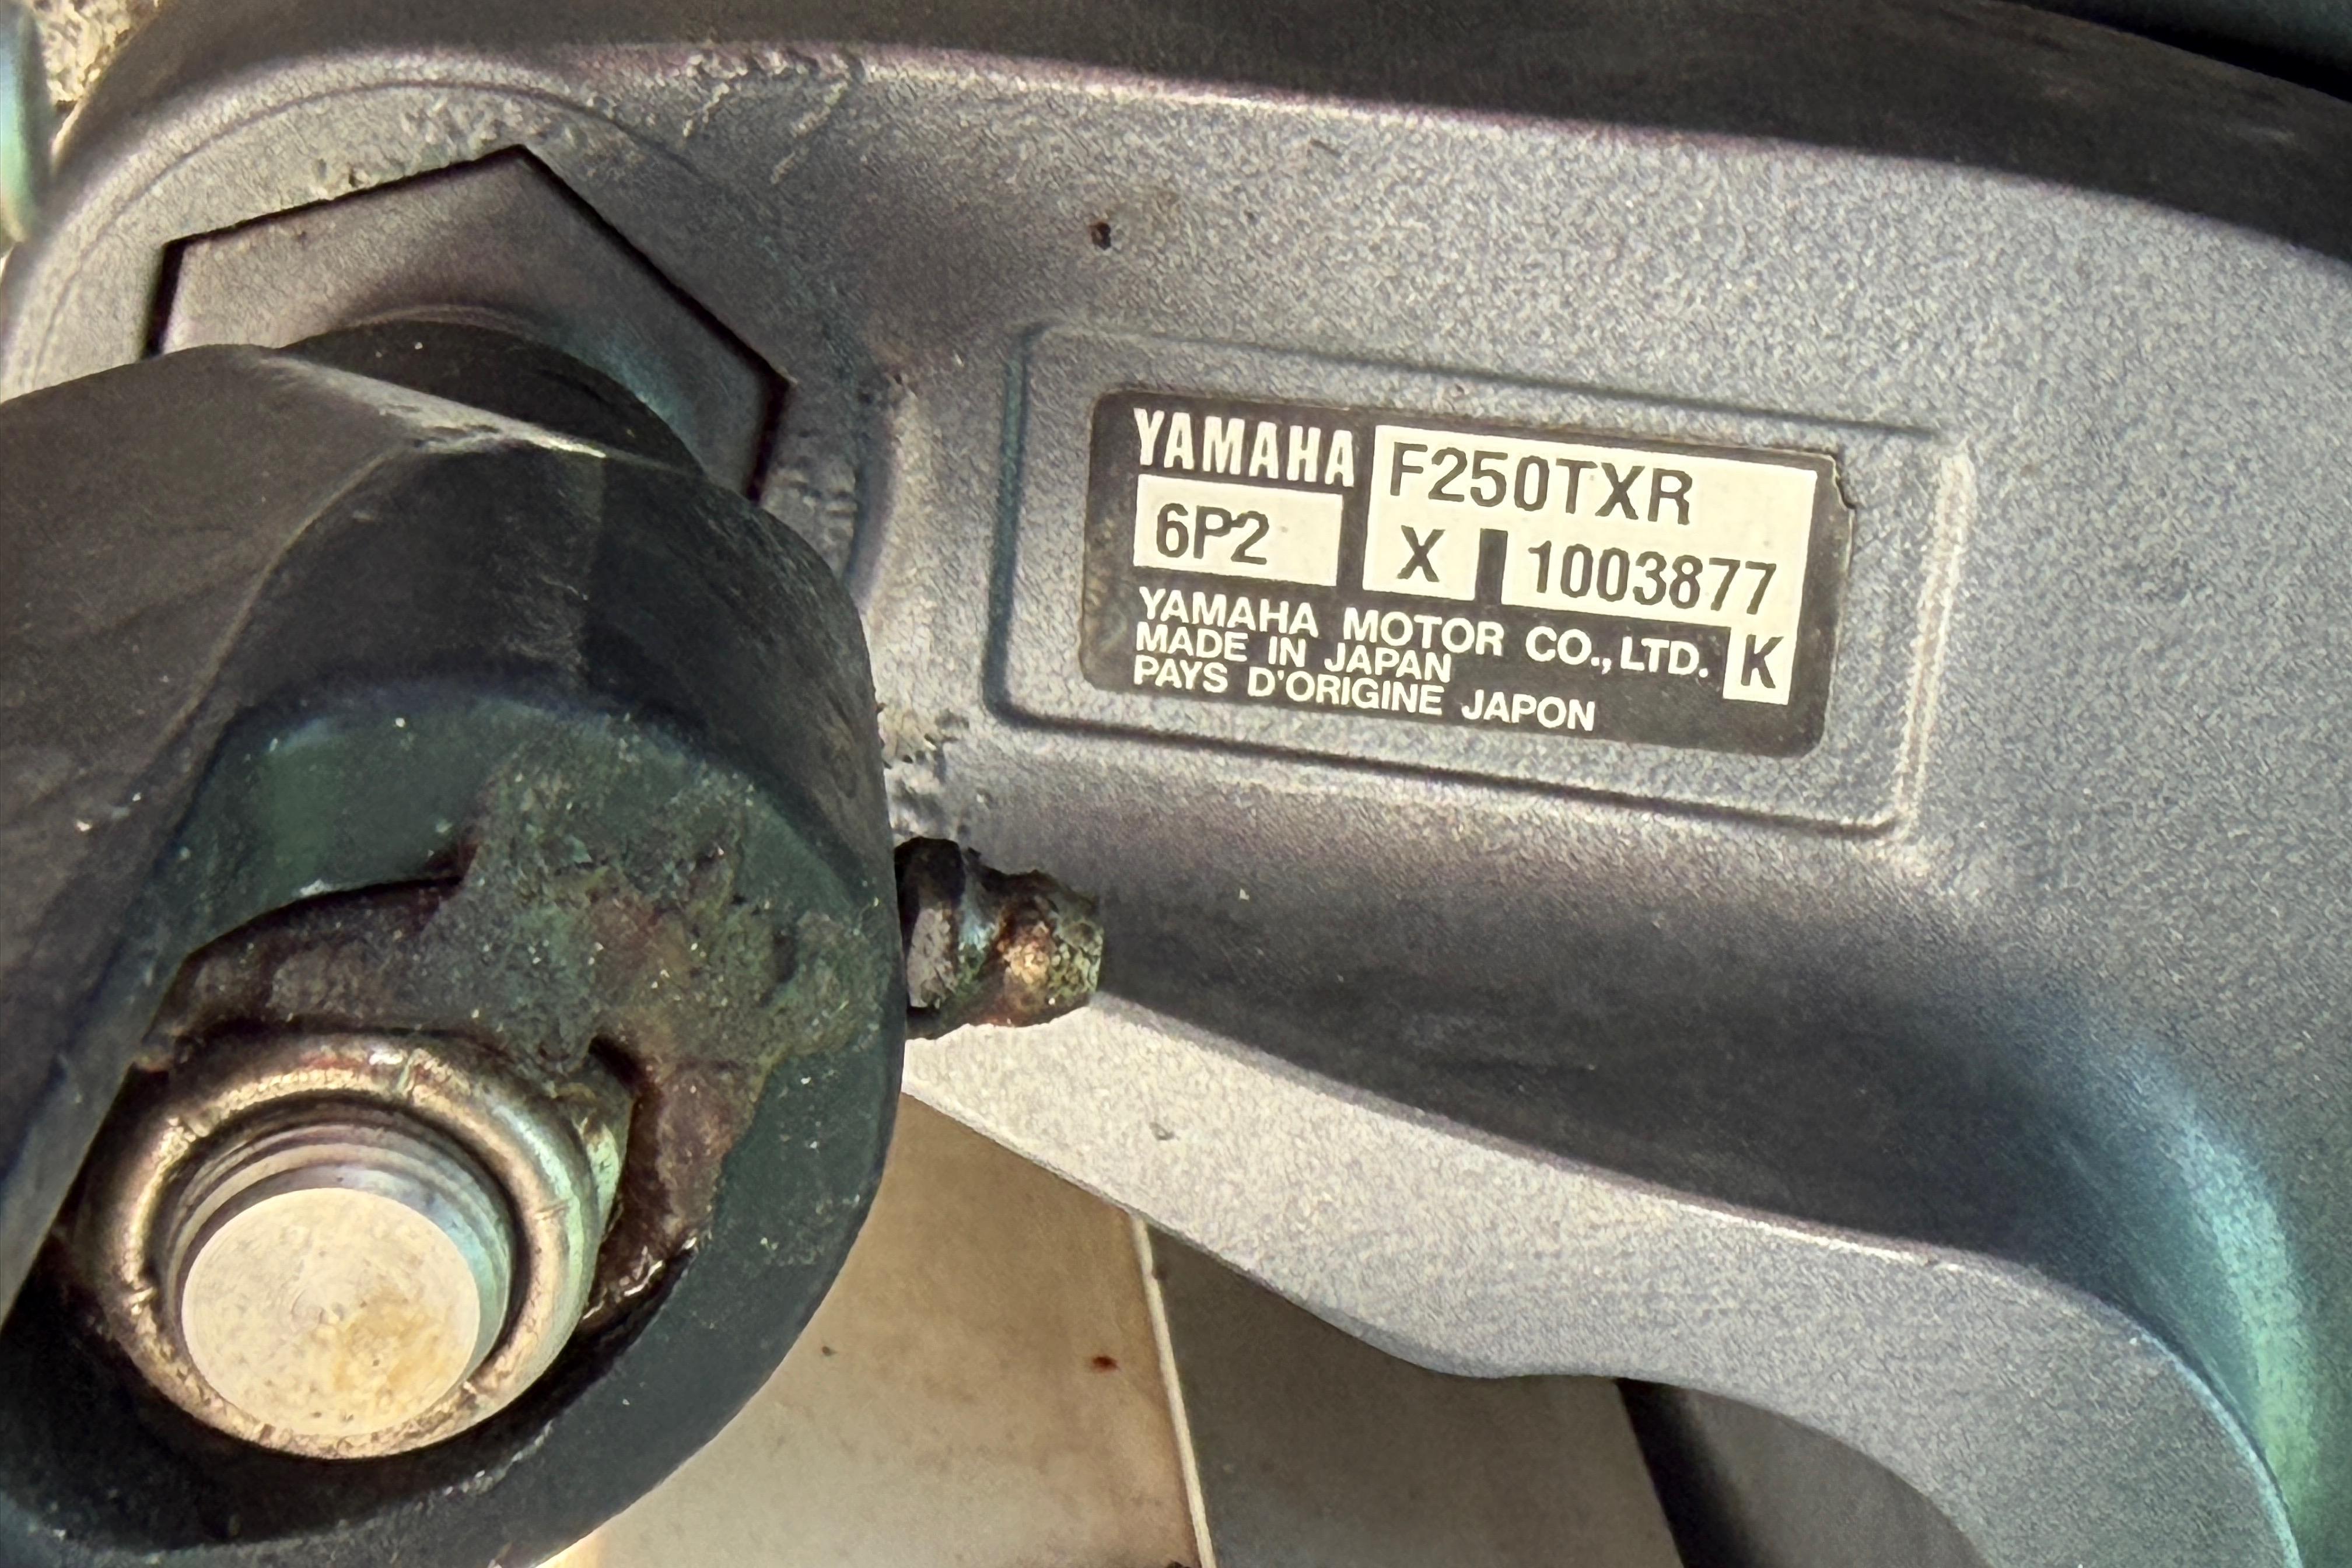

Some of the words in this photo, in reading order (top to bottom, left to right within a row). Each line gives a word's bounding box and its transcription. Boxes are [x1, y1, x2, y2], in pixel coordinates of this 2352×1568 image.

[1133, 408, 1354, 488] YAMAHA
[1390, 442, 1693, 526] F250TXR
[1156, 503, 1270, 565] 6P2
[1396, 525, 1446, 582] X
[1528, 540, 1777, 615] 1003877
[1136, 621, 1250, 662] MADE
[1268, 636, 1307, 667] IN
[1324, 642, 1451, 683] JAPAN
[1139, 586, 1319, 638] YAMAHA
[1343, 607, 1504, 657] MOTOR
[1525, 626, 1709, 678] CO.,LTD.
[1740, 634, 1785, 690] K
[1133, 654, 1228, 694] PAYS
[1247, 666, 1446, 716] D'ORIGINE
[1461, 689, 1596, 733] JAPON
